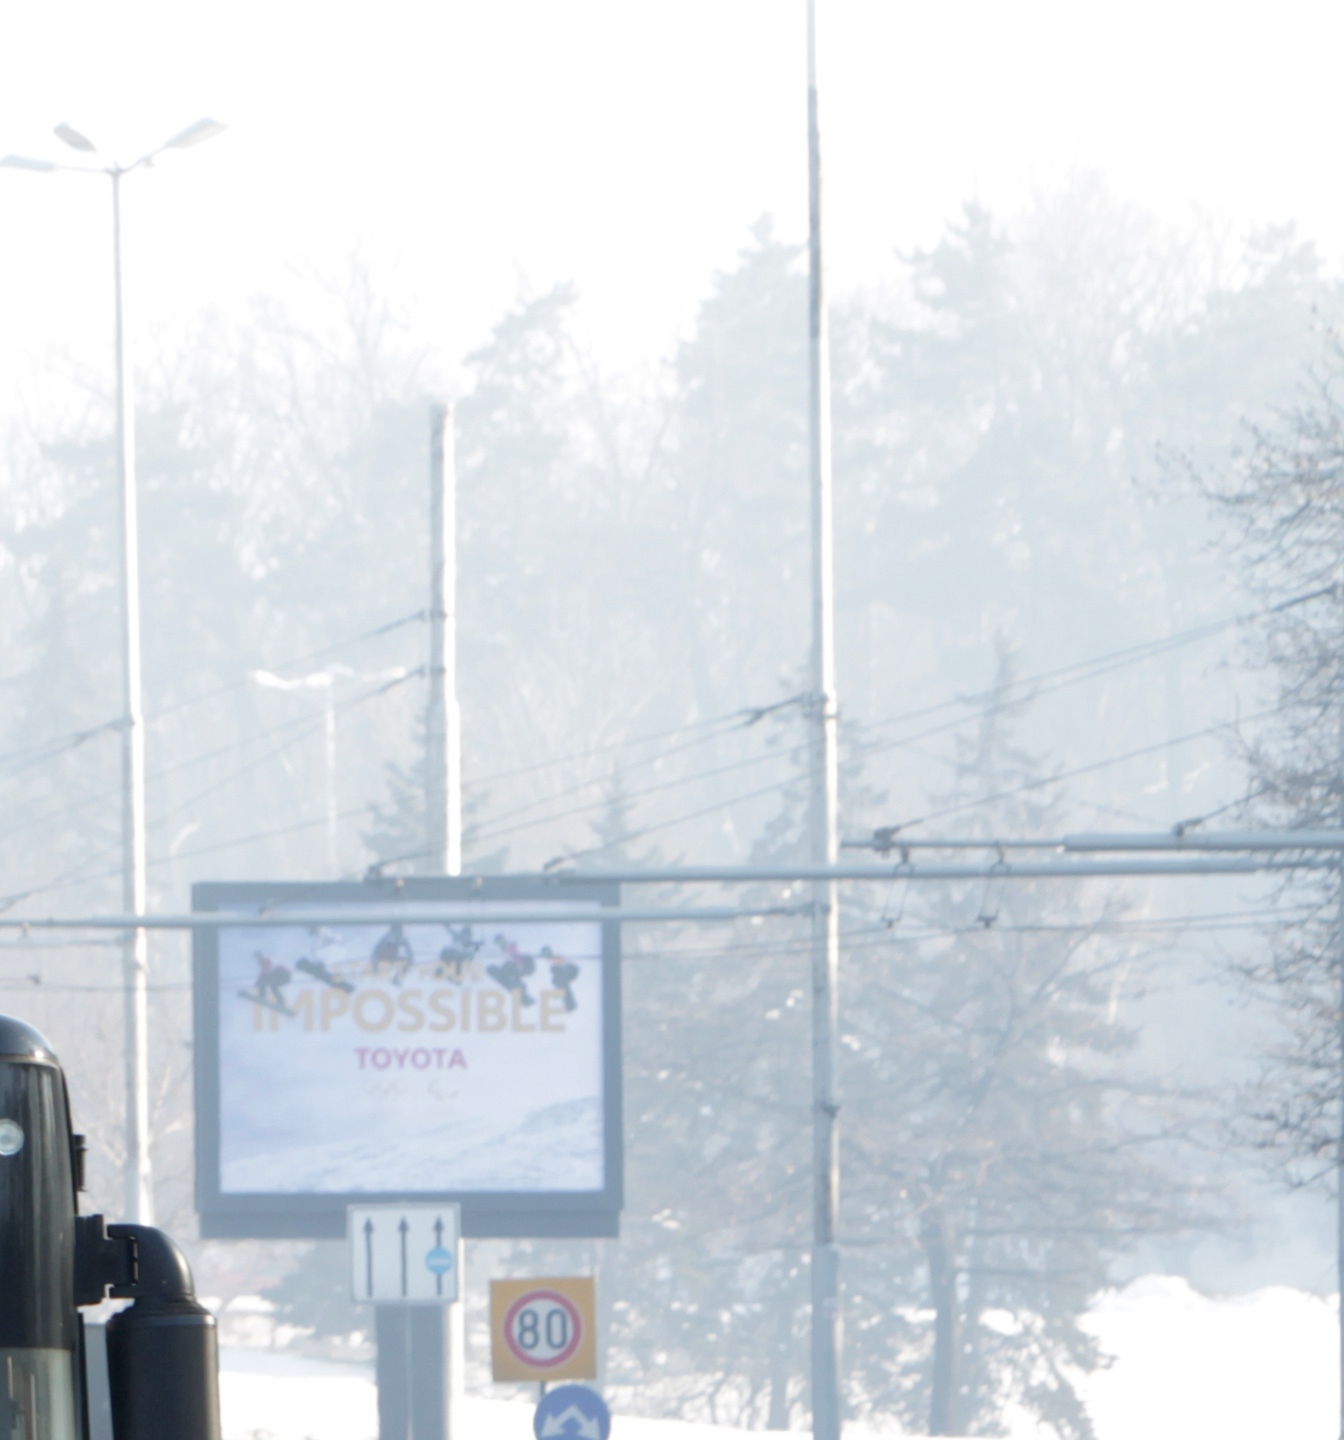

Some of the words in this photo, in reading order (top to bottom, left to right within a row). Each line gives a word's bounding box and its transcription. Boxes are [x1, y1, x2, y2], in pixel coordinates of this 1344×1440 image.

[252, 987, 567, 1033] IMPOSSIBLE
[354, 1047, 468, 1070] TOYOTA
[517, 1308, 568, 1351] 80
